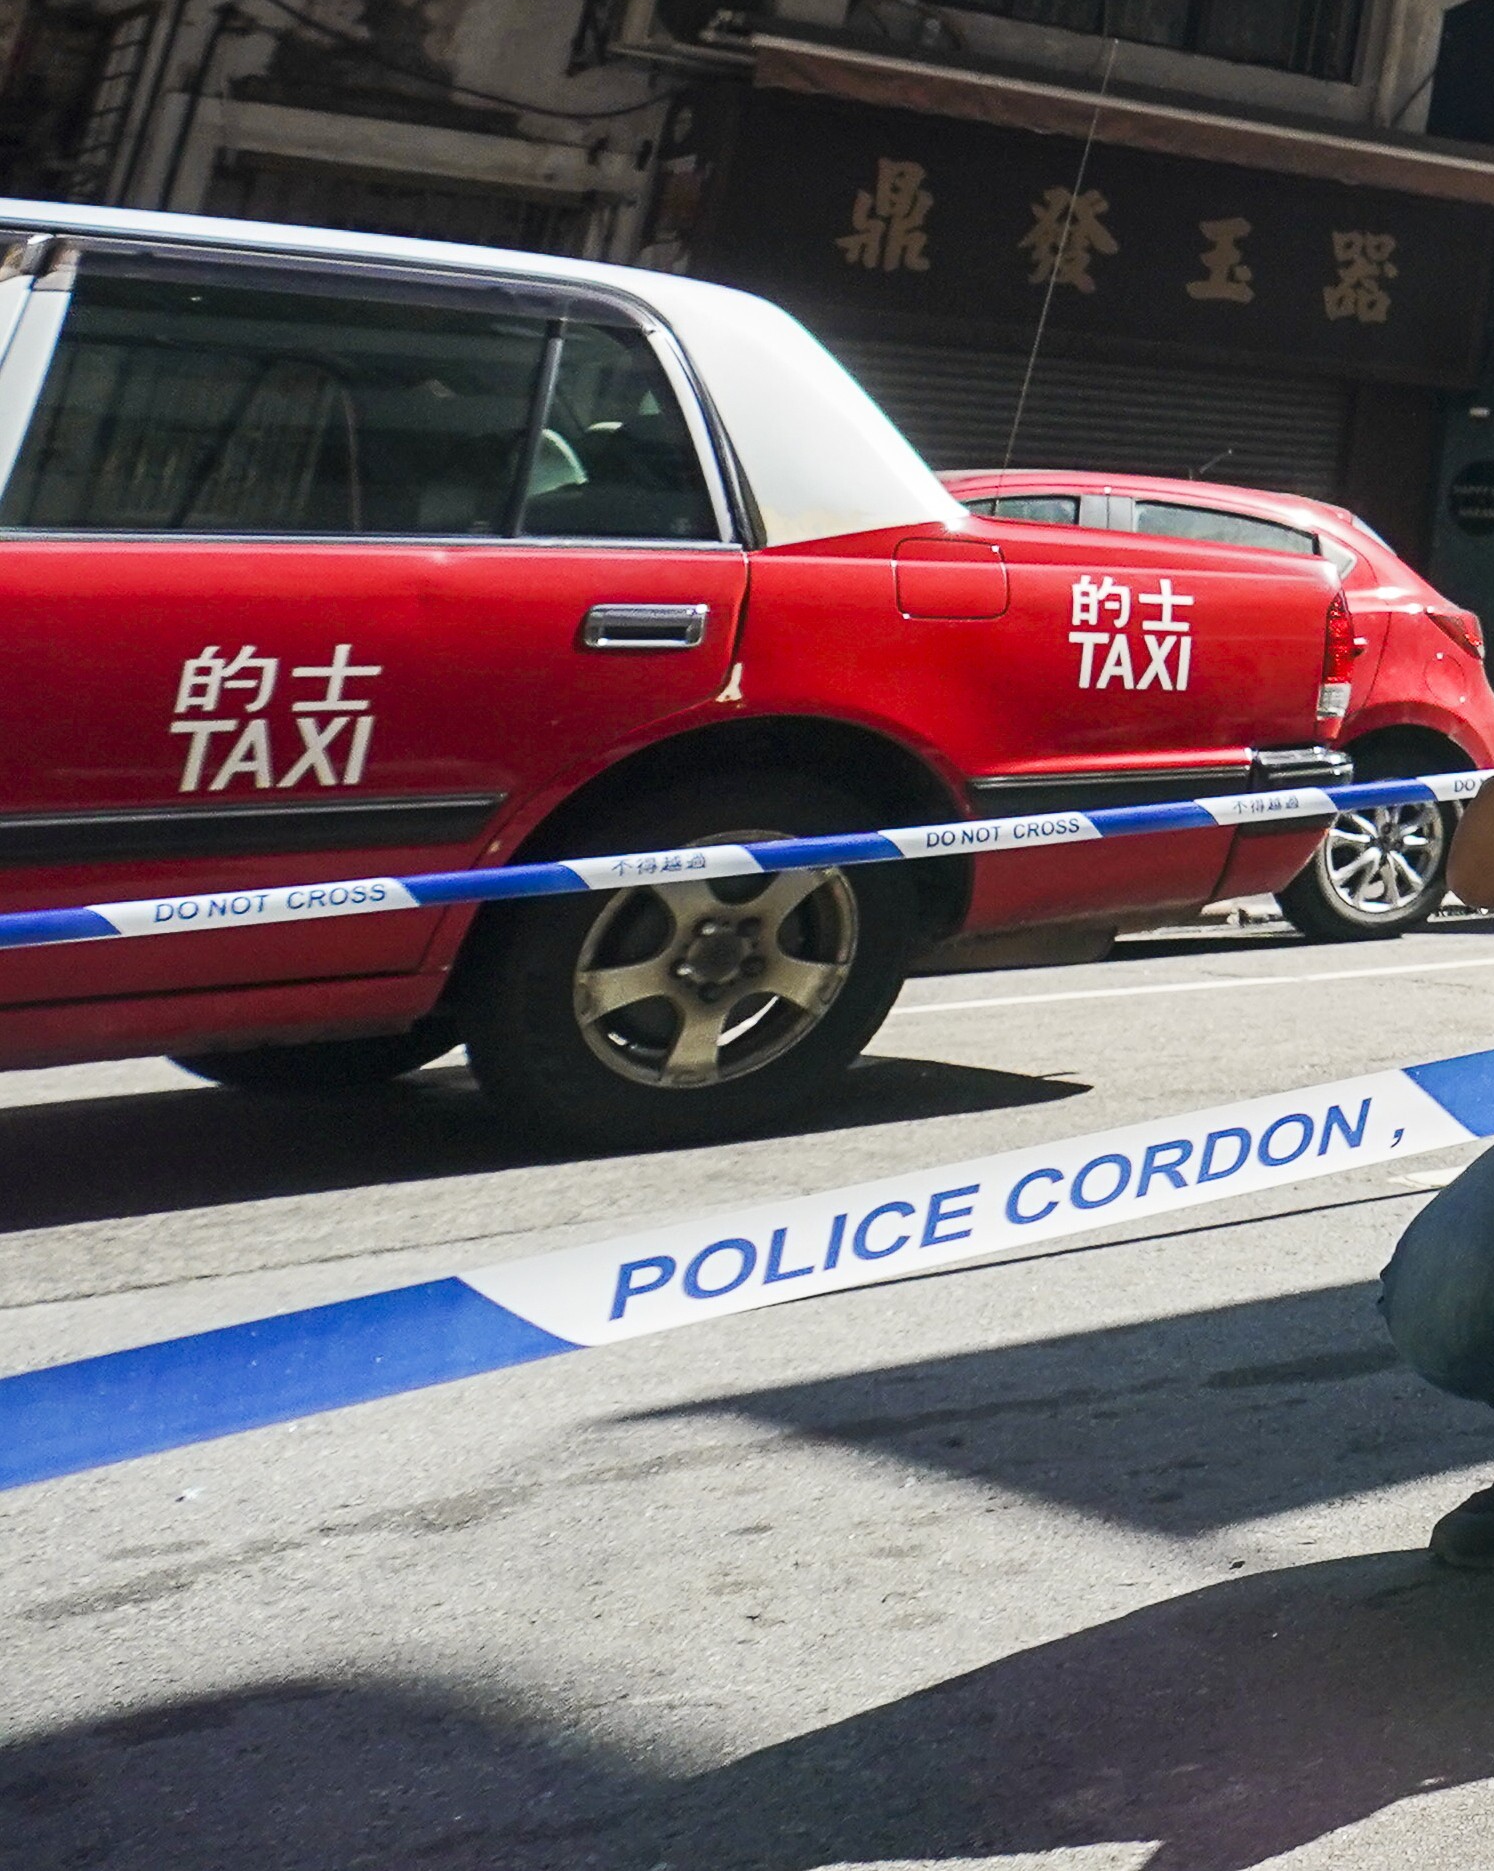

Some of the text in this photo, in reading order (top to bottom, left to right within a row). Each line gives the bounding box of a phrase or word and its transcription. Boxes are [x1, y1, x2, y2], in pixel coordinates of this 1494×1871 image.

[836, 155, 1399, 325] 鼎發玉器
[1070, 575, 1195, 634] 的士
[173, 644, 383, 716] 的士
[1068, 631, 1193, 693] TAXI
[171, 714, 376, 793] TAXI
[926, 817, 1081, 849] DO NOT CROSS
[154, 883, 388, 924] DO NOT CROSS
[608, 1183, 982, 1323] POLICE
